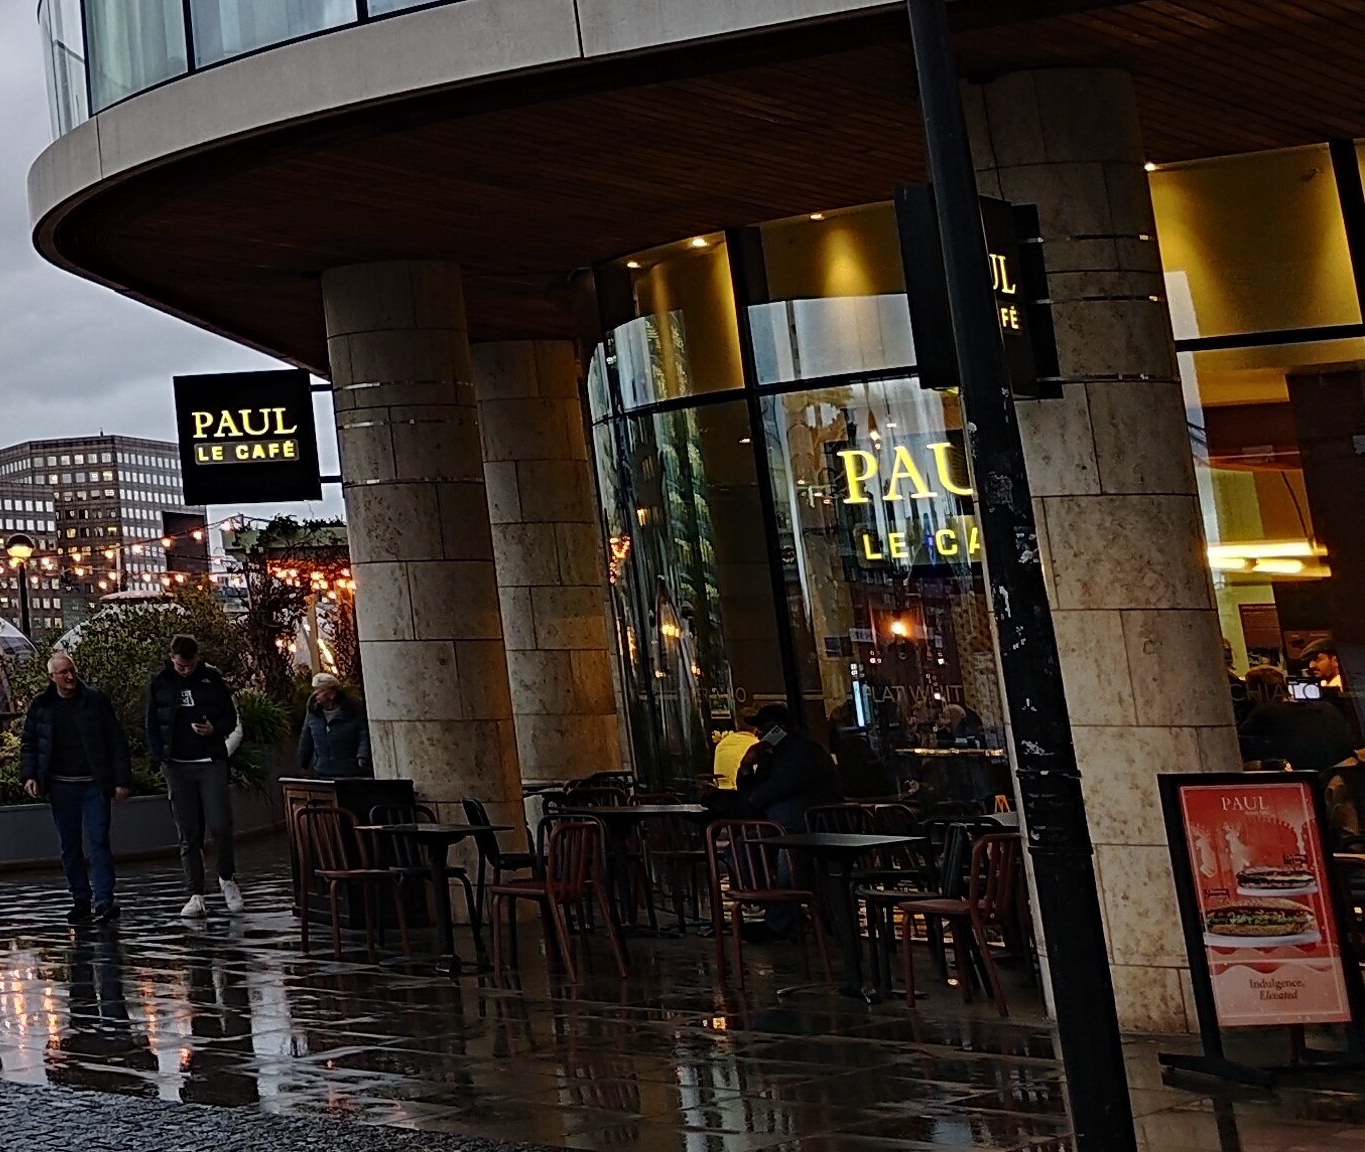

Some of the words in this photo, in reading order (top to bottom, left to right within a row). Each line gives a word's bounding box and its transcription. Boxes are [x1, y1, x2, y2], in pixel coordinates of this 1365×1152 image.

[191, 407, 298, 438] PAUL
[198, 446, 224, 461] LE
[235, 440, 295, 460] CAFÉ
[862, 532, 909, 560] LE
[1221, 796, 1270, 811] PAUL
[1259, 989, 1298, 1001] Elevated
